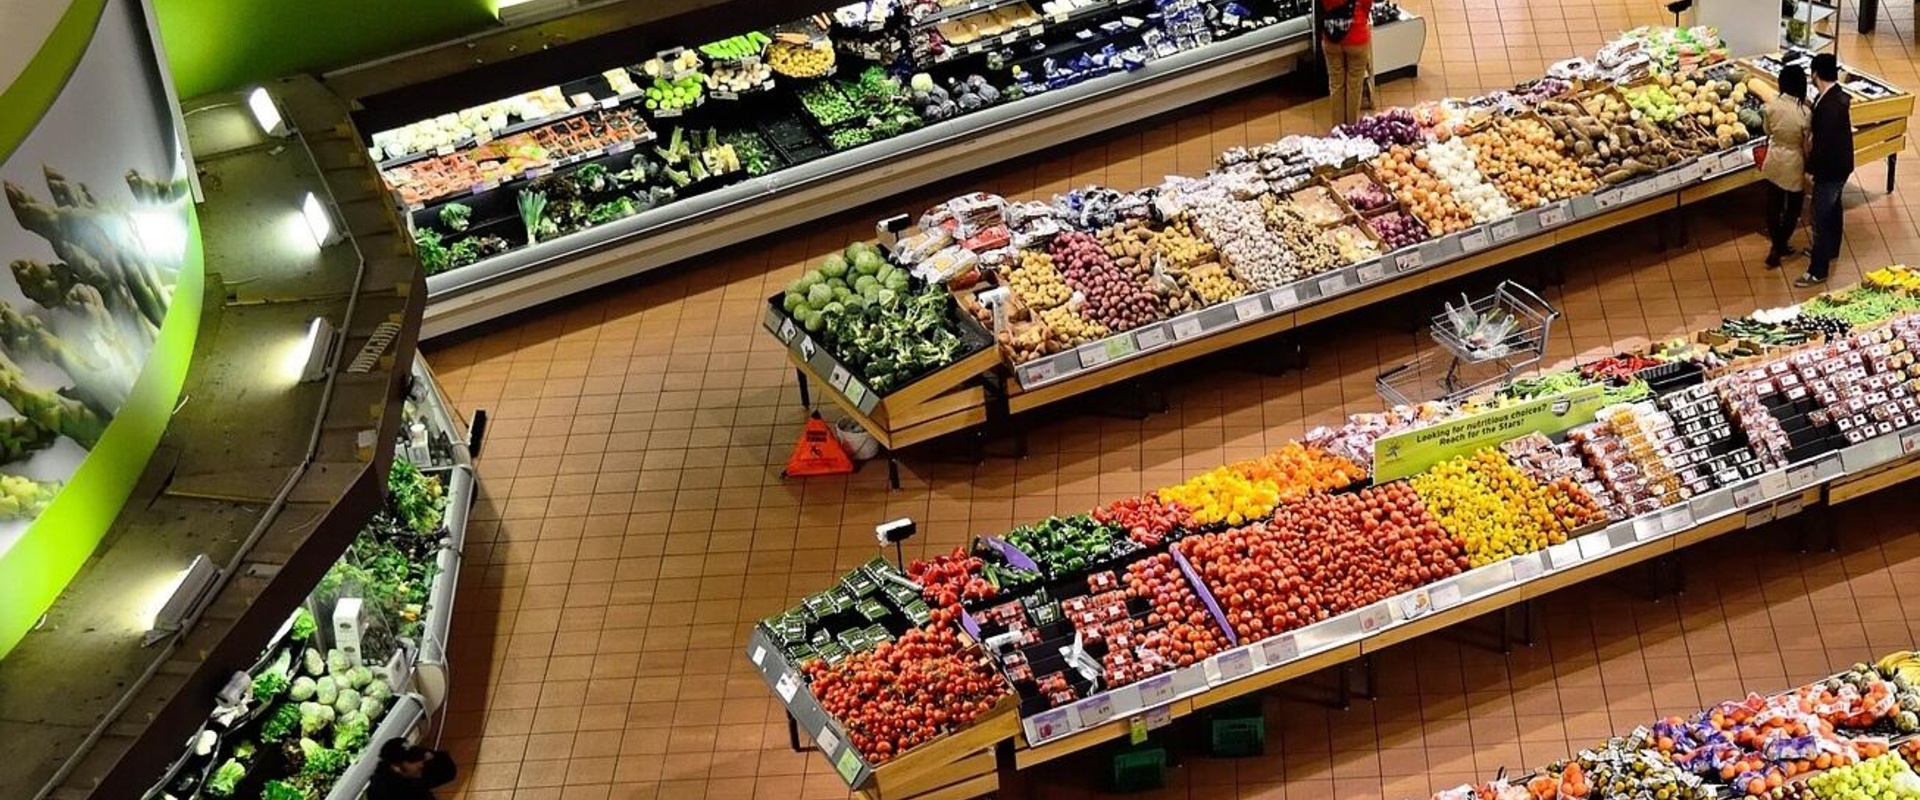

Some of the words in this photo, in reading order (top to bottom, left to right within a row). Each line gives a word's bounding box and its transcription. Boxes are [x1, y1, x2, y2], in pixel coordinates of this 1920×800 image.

[1417, 429, 1450, 443] Looking
[1452, 425, 1465, 434] for
[1467, 414, 1508, 430] nutritious
[1511, 403, 1547, 419] choices?
[1439, 433, 1465, 446] Reach
[1468, 430, 1480, 439] for
[1482, 426, 1496, 435] the
[1499, 418, 1525, 431] Stars!
